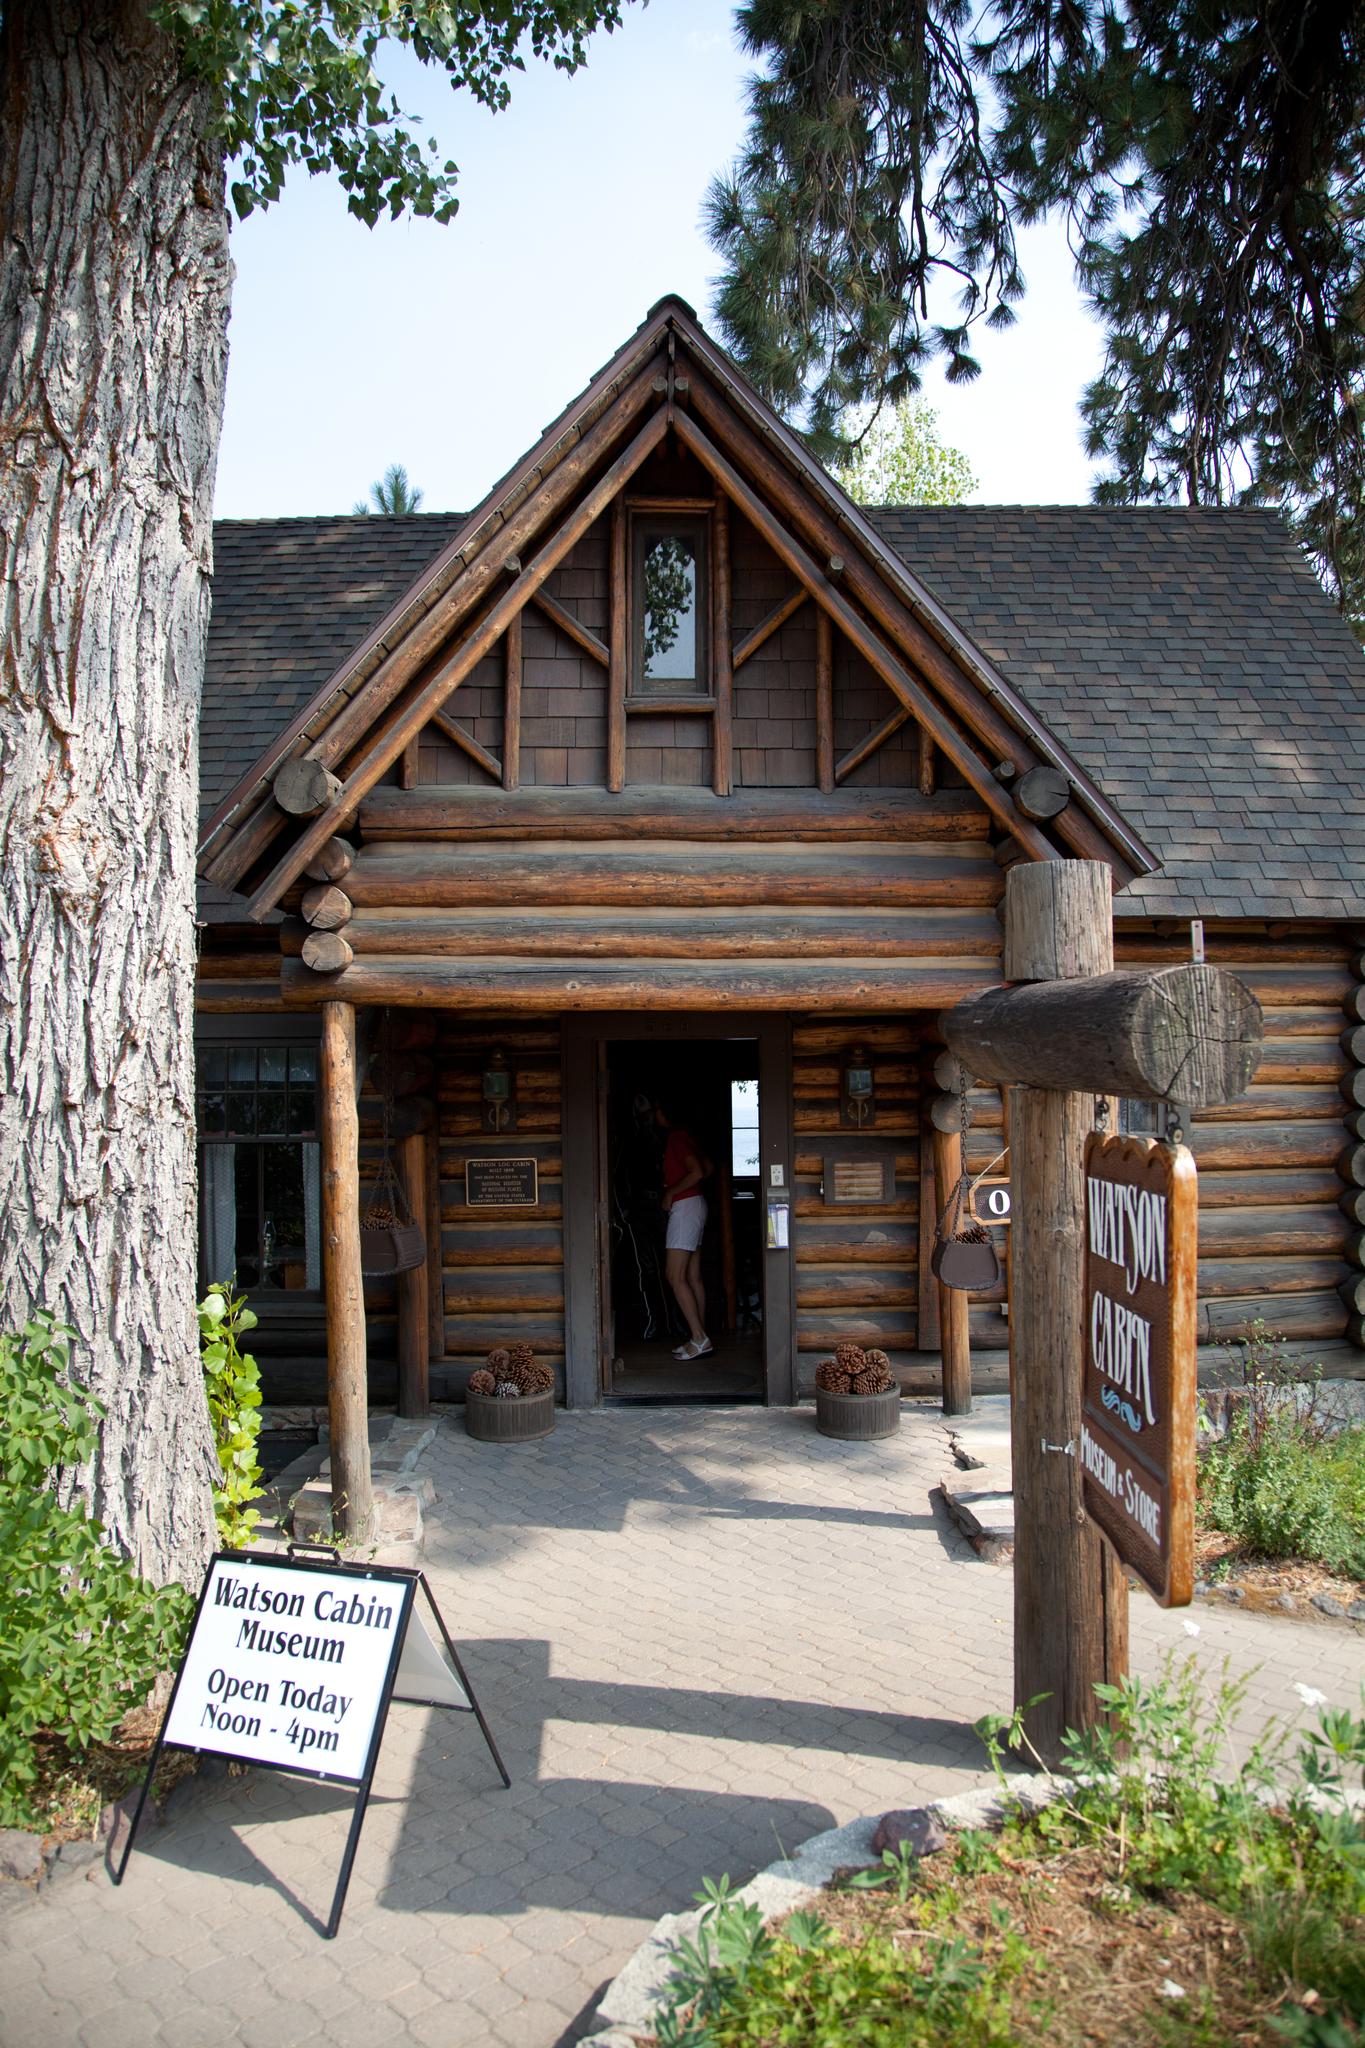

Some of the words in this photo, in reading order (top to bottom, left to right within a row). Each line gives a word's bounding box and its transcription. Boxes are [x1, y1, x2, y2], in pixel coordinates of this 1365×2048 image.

[1088, 1177, 1166, 1295] WATSON
[1091, 1290, 1156, 1426] CABIN
[1080, 1423, 1117, 1498] MUSEUM
[1117, 1473, 1124, 1496] &
[1125, 1468, 1161, 1546] STORE
[214, 1576, 305, 1617] Watson
[314, 1590, 393, 1630] Cabin
[235, 1618, 345, 1664] Museum
[207, 1668, 270, 1704] Open
[279, 1679, 353, 1724] Today
[200, 1703, 261, 1737] Noon
[285, 1716, 340, 1754] 4pm
